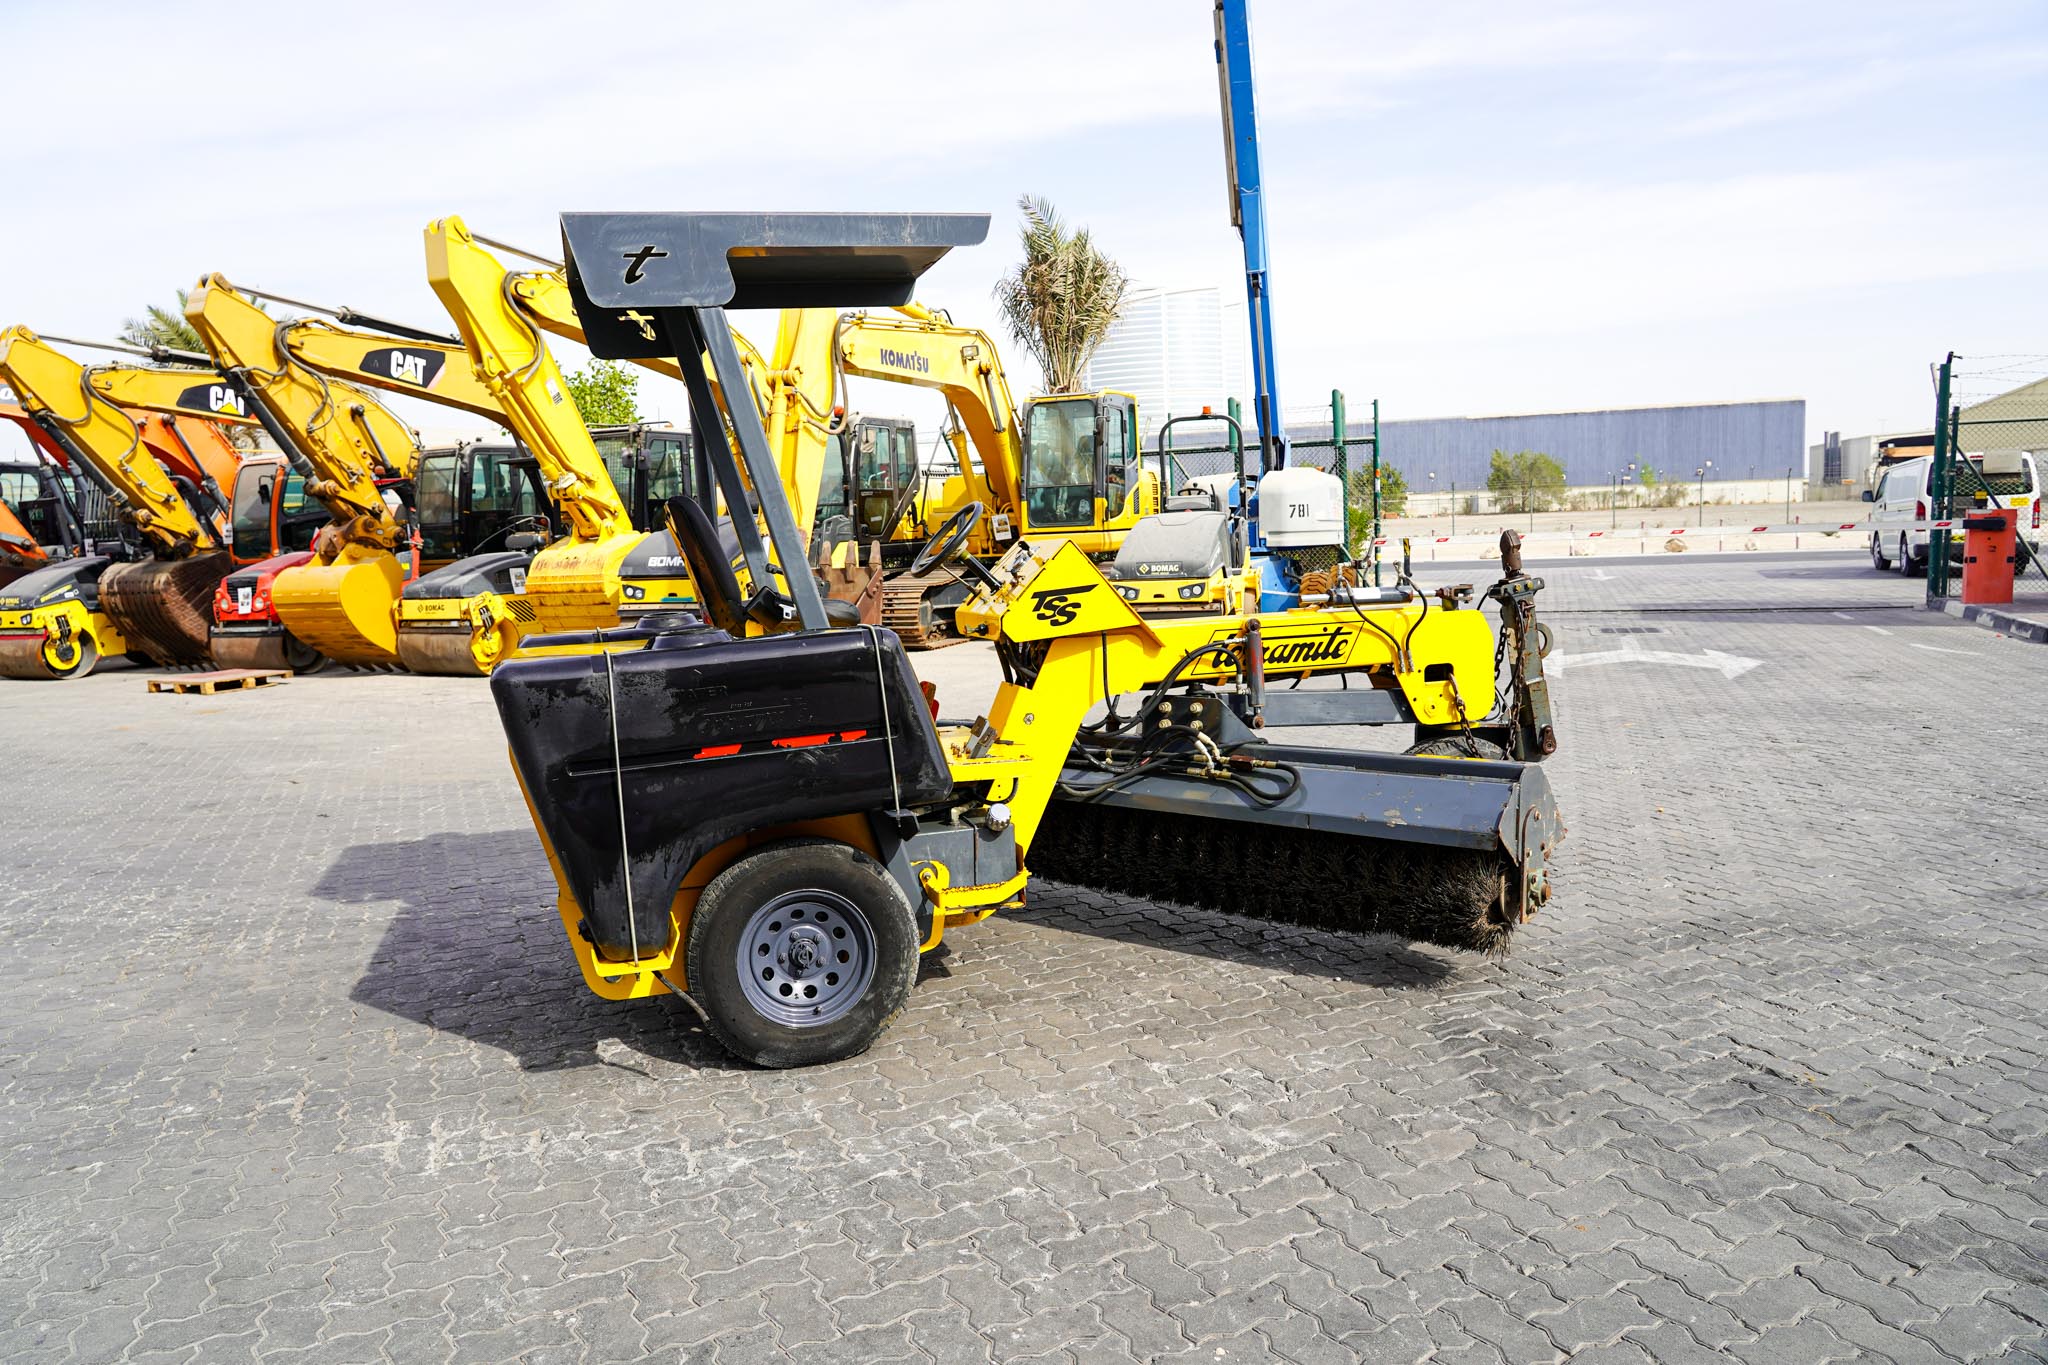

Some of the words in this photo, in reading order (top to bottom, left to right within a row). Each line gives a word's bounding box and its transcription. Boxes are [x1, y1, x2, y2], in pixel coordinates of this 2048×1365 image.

[622, 245, 669, 285] t
[390, 350, 427, 385] CAT
[880, 348, 929, 374] KOMATSU
[1289, 503, 1310, 519] 781
[1151, 564, 1179, 572] BOMAG
[1030, 583, 1100, 627] TSS
